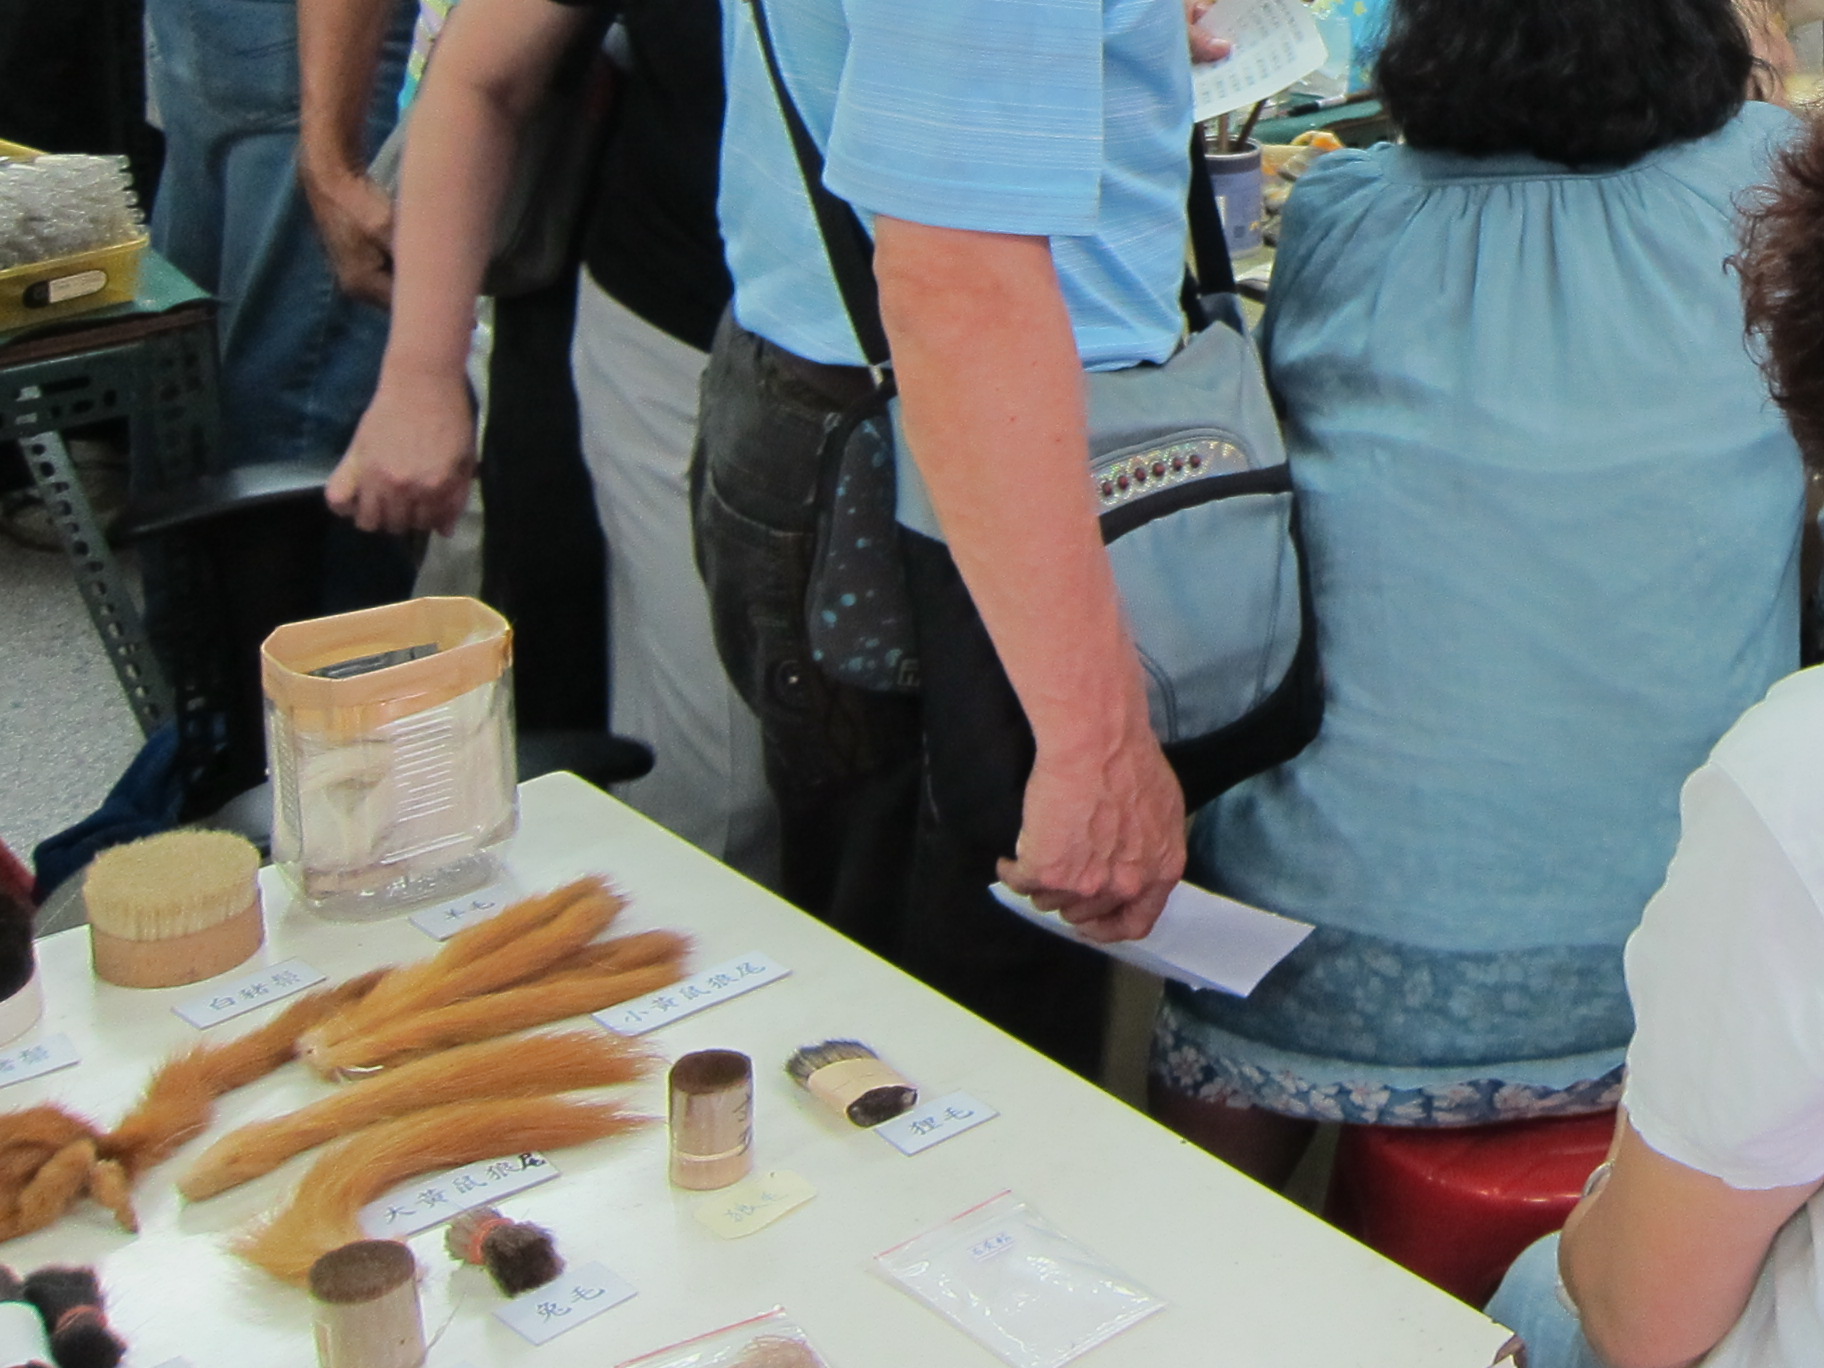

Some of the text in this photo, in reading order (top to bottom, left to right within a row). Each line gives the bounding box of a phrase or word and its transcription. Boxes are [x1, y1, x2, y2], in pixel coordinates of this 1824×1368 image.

[624, 961, 767, 1024] 小黃鼠狼尾
[384, 1151, 547, 1224] 大黃鼠狼尾
[535, 1285, 606, 1324] 兔毛
